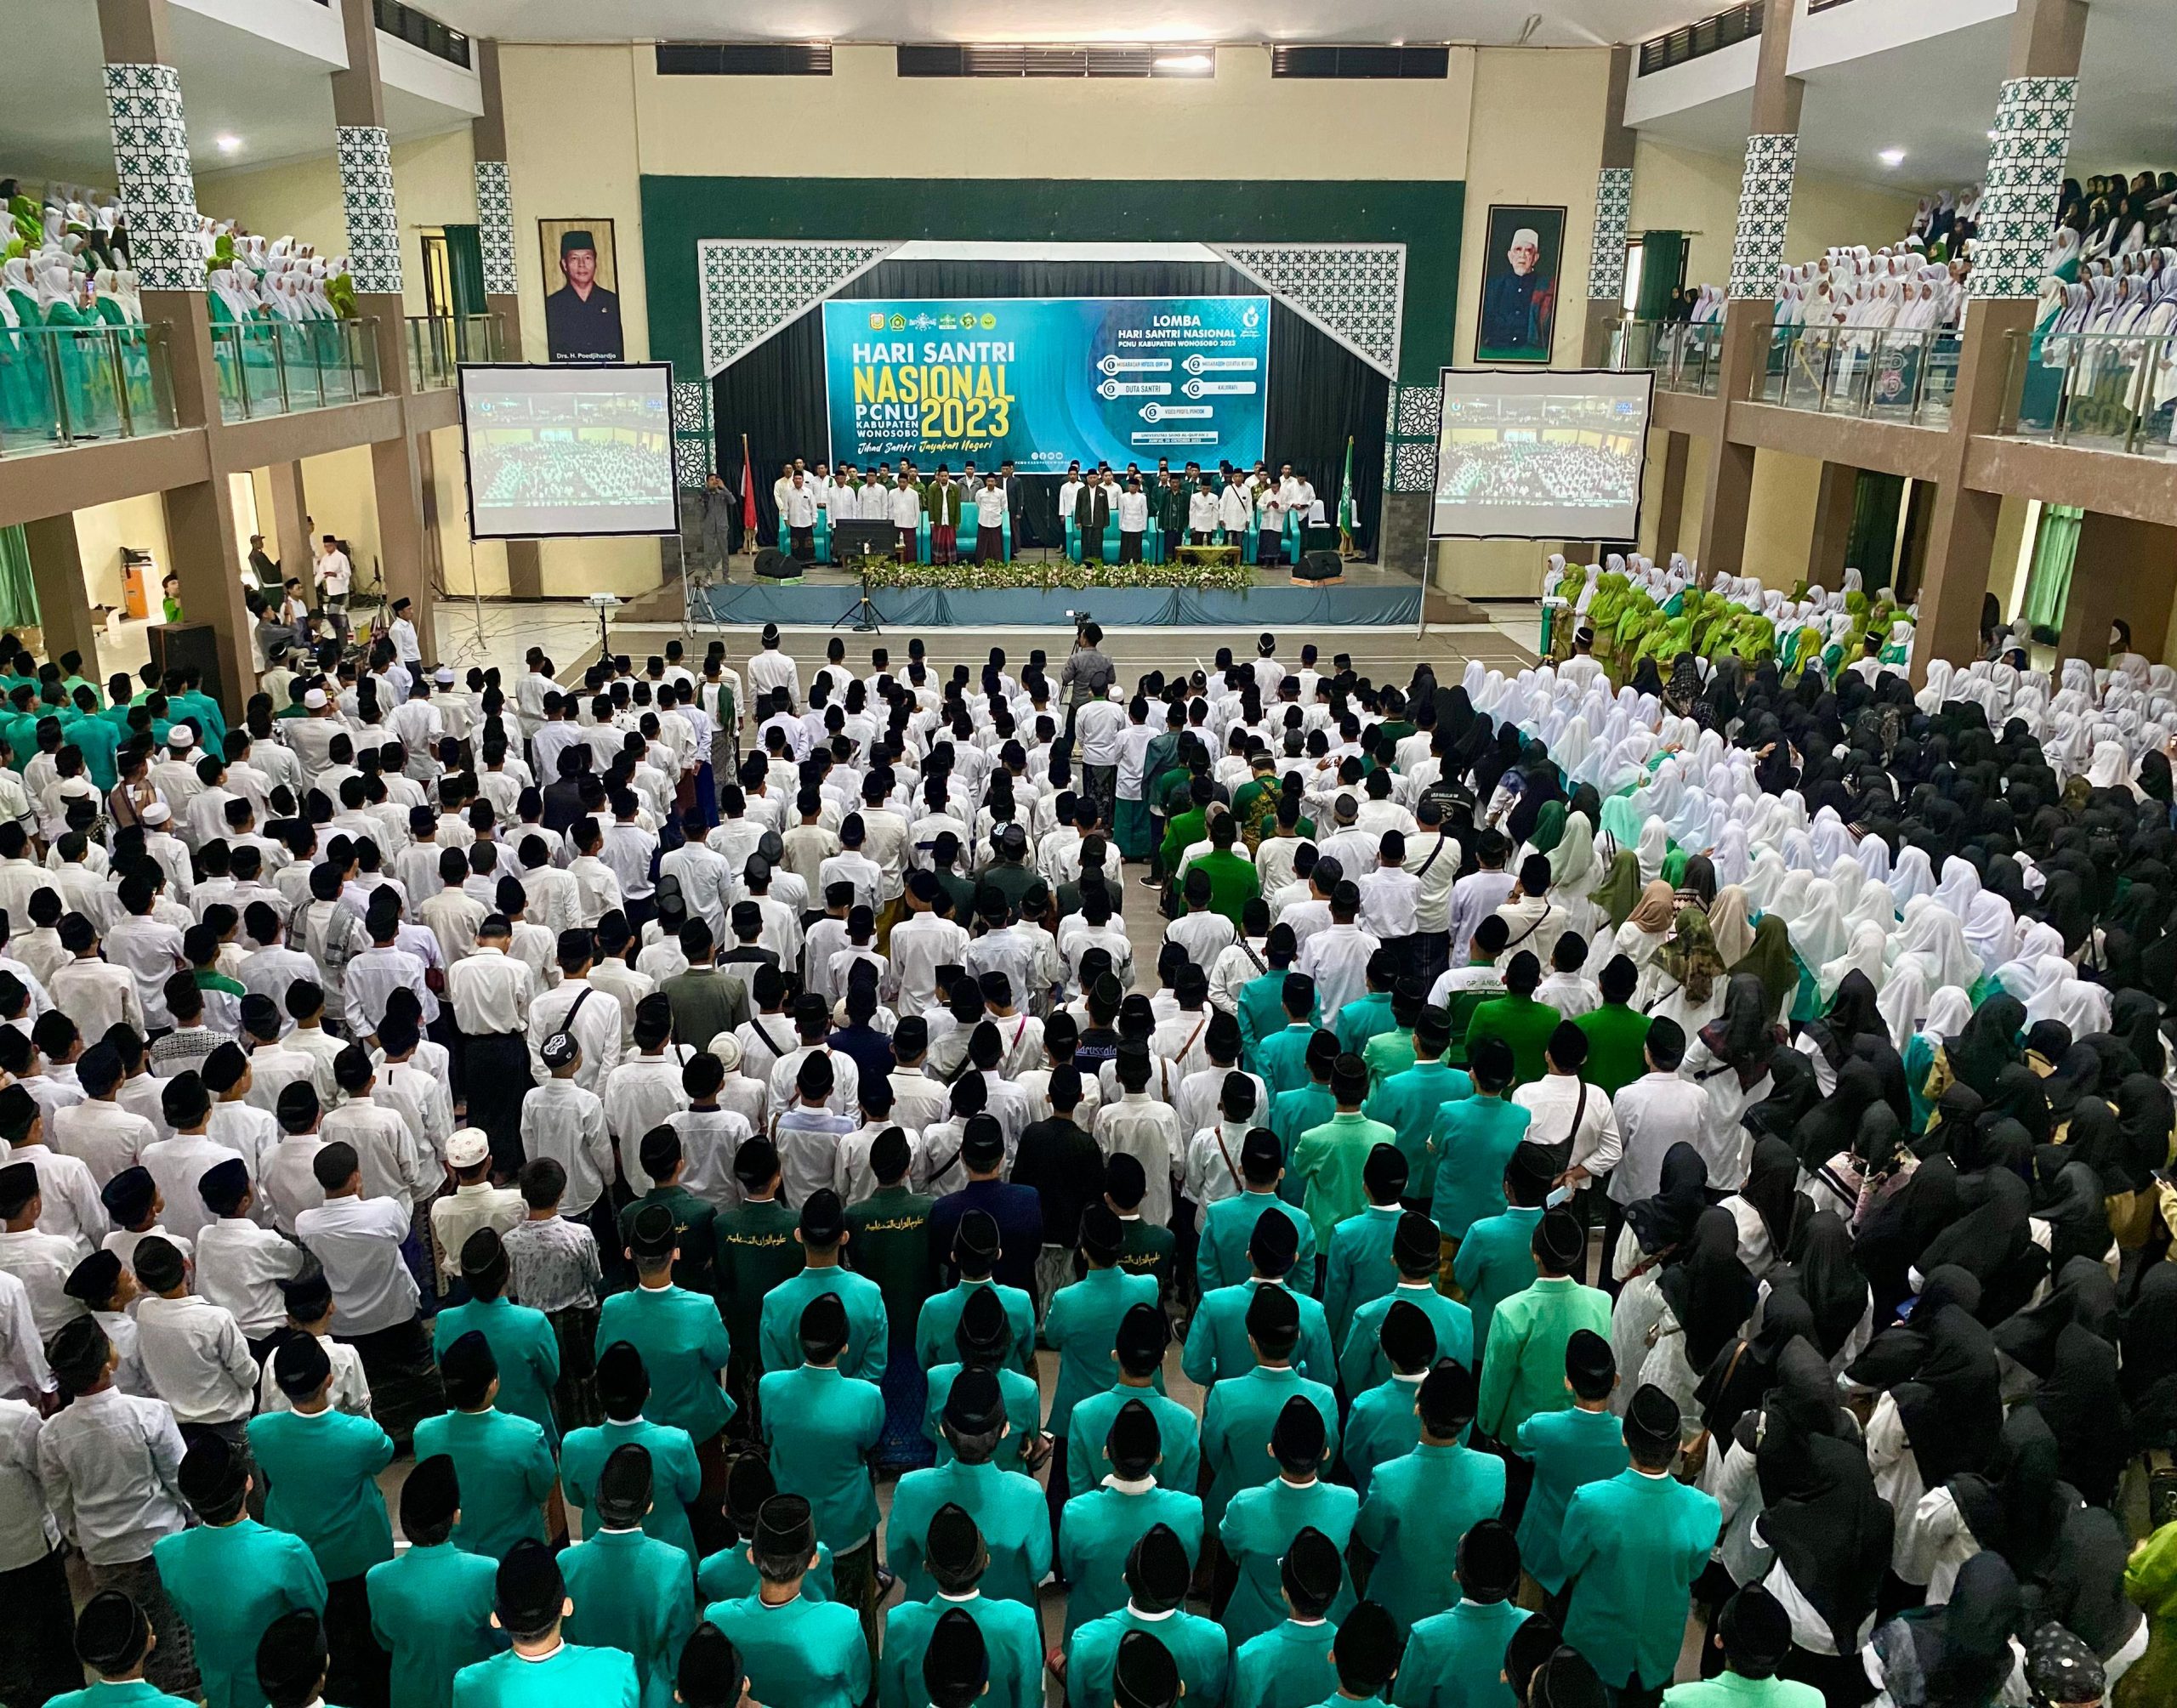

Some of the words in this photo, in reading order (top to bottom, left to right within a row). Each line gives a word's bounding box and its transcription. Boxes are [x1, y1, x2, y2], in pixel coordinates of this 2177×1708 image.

[1153, 315, 1201, 327] LOMBA
[1118, 330, 1143, 338] HARI
[1145, 329, 1180, 338] SANTRI
[1184, 329, 1236, 338] NASIONAL
[852, 343, 914, 363] HARI
[923, 342, 1015, 363] SANTRI
[854, 365, 1015, 403] NASIONAL
[855, 404, 918, 420] PCNU
[920, 398, 1009, 438] 2023
[855, 420, 918, 428] KABUPATEN
[857, 429, 918, 438] WONOSOBO
[857, 442, 882, 454] Jihad
[884, 441, 916, 454] Santri
[919, 440, 959, 454] Jayakan
[961, 440, 993, 452] Negeri
